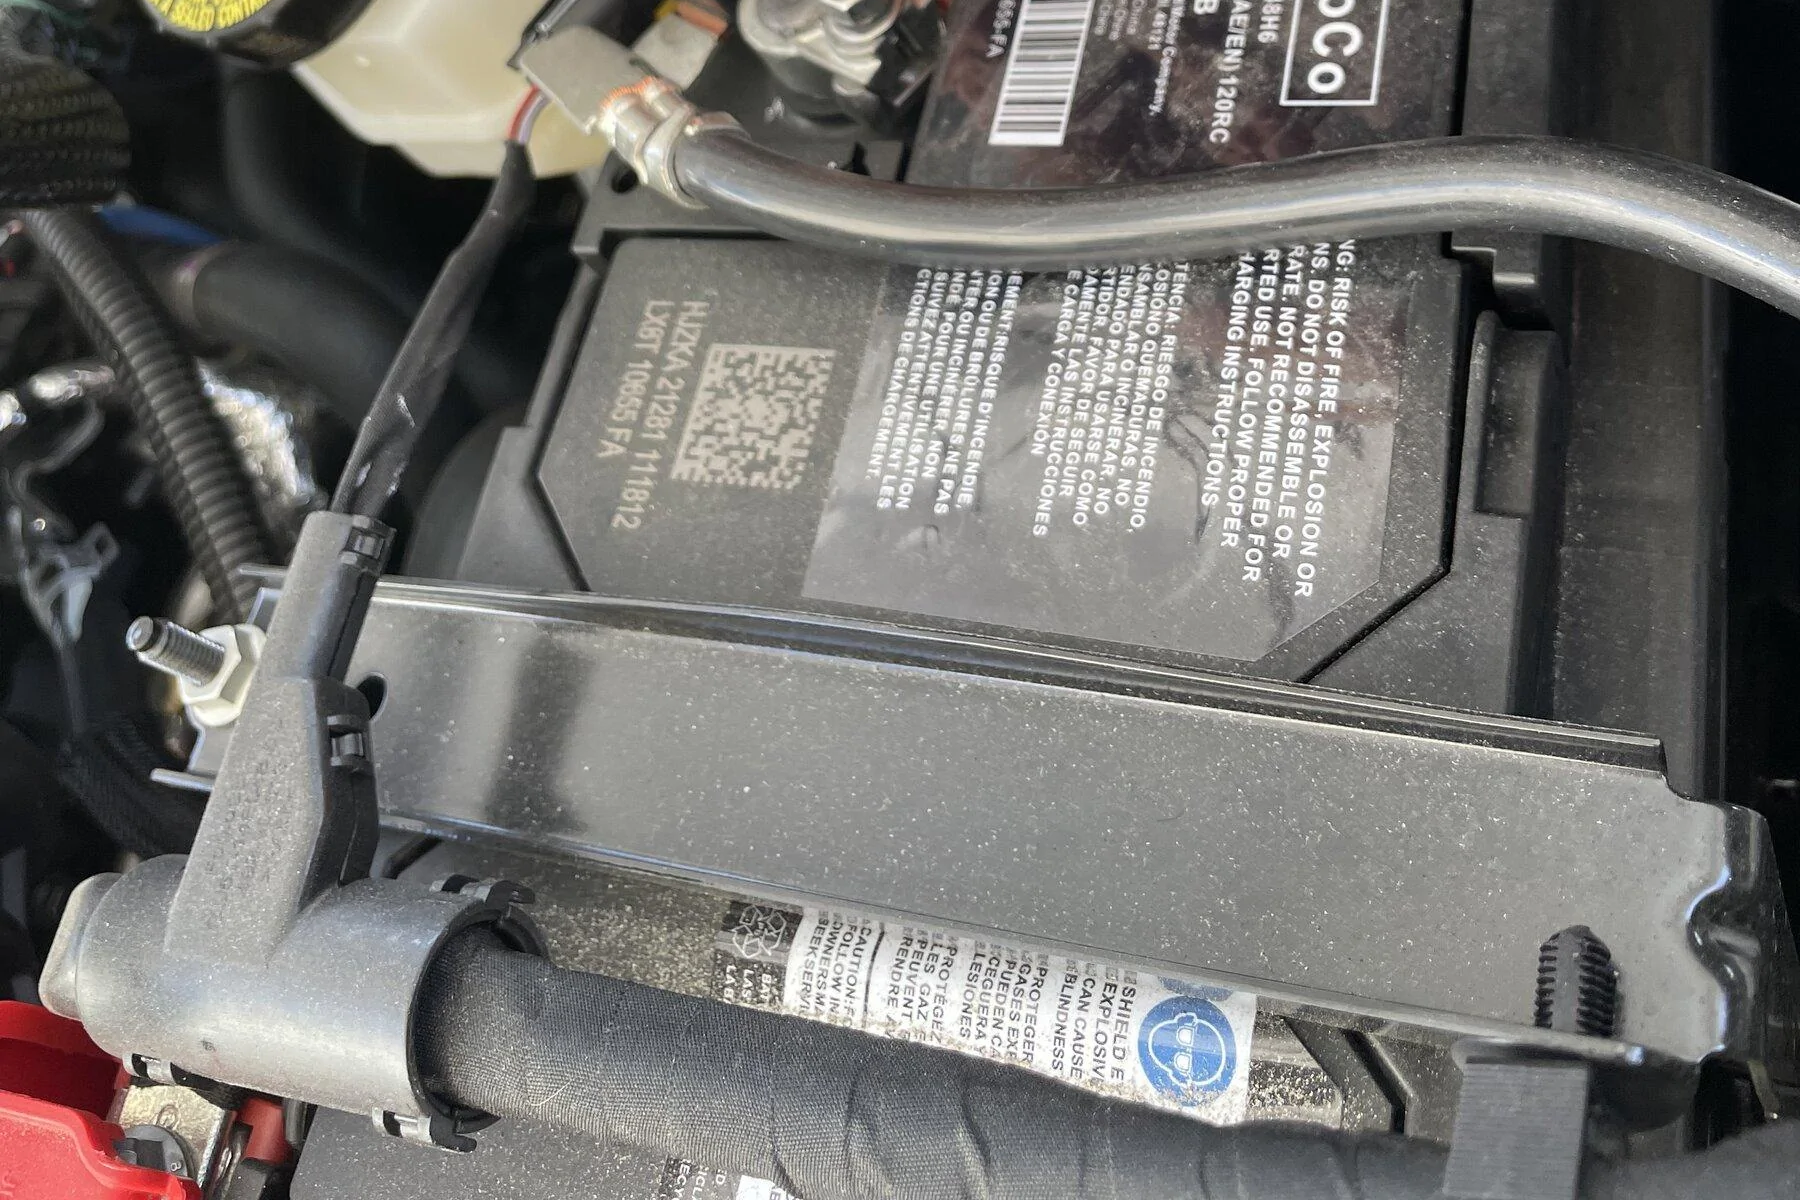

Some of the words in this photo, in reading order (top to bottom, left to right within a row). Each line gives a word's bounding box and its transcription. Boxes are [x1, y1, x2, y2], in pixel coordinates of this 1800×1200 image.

[1209, 75, 1238, 144] 120RC
[922, 272, 949, 329] SUIVEZ
[956, 312, 974, 334] OU
[978, 300, 997, 323] OU
[1054, 284, 1080, 343] CARGA
[1306, 280, 1325, 309] DO
[1328, 277, 1352, 326] RISK
[661, 302, 709, 372] HJZKA
[898, 332, 916, 353] DE
[932, 312, 957, 357] POUR
[972, 327, 990, 348] DE
[1052, 348, 1065, 359] Y
[1249, 306, 1272, 352] USE.
[1276, 307, 1297, 349] NOT
[1300, 314, 1321, 356] NOT
[1325, 331, 1344, 359] OF
[922, 362, 945, 396] UNE
[931, 339, 968, 434] INCINÉRER.
[1063, 348, 1083, 381] LAS
[1080, 337, 1103, 393] FAVOR
[1099, 339, 1121, 385] PARA
[1152, 335, 1177, 402] RIESGO
[641, 377, 685, 440] 21281
[865, 357, 909, 480] CHARGEMENT.
[887, 331, 934, 471] ATTENTIVEMENT
[1031, 363, 1063, 455] CONEXIÓN
[1073, 399, 1091, 422] DE
[1120, 340, 1158, 471] QUEMADURAS.
[1147, 407, 1165, 431] DE
[1235, 358, 1265, 449] FOLLOW
[1314, 365, 1340, 418] FIRE,
[597, 428, 633, 457] FA
[895, 400, 934, 509] UTILISATION
[1084, 391, 1111, 463] USARSE
[1099, 377, 1132, 481] INCINERAR.
[1201, 346, 1242, 506] INSTRUCTIONS
[1250, 354, 1290, 528] RECOMMENDED
[1278, 361, 1315, 518] DISASSEMBLE
[921, 440, 943, 478] NON
[955, 402, 993, 509] D'INCENDIE,
[1033, 387, 1075, 536] INSTRUCCIONES
[1059, 428, 1086, 497] SEGUIR
[1126, 436, 1159, 533] INCENDIO,
[610, 449, 661, 529] 111812
[877, 475, 897, 509] LES
[934, 479, 955, 514] PAS
[1072, 469, 1096, 525] COMO
[1094, 488, 1112, 514] NO
[1114, 479, 1132, 506] NO
[1220, 454, 1251, 547] PROPER
[1300, 425, 1333, 556] EXPLOSION
[1242, 534, 1265, 581] FOR
[1272, 525, 1292, 558] OR
[1294, 563, 1315, 597] OR
[832, 924, 857, 992] FOLLOW
[887, 936, 913, 1008] RENDRE
[901, 940, 928, 1022] PEUVENT
[924, 944, 943, 973] LES
[917, 984, 930, 1021] GAZ
[960, 953, 986, 1038] LESIONES
[976, 957, 1000, 1040] CEGUERA
[992, 960, 1017, 1030] PUEDEN
[1010, 964, 1032, 1022] GASES
[1022, 967, 1048, 1062] PROTEGER
[1052, 974, 1078, 1070] BLINDNESS
[1078, 978, 1095, 1012] CAN
[1070, 1018, 1087, 1079] CAUSE
[1112, 986, 1136, 1060] SHIELD
